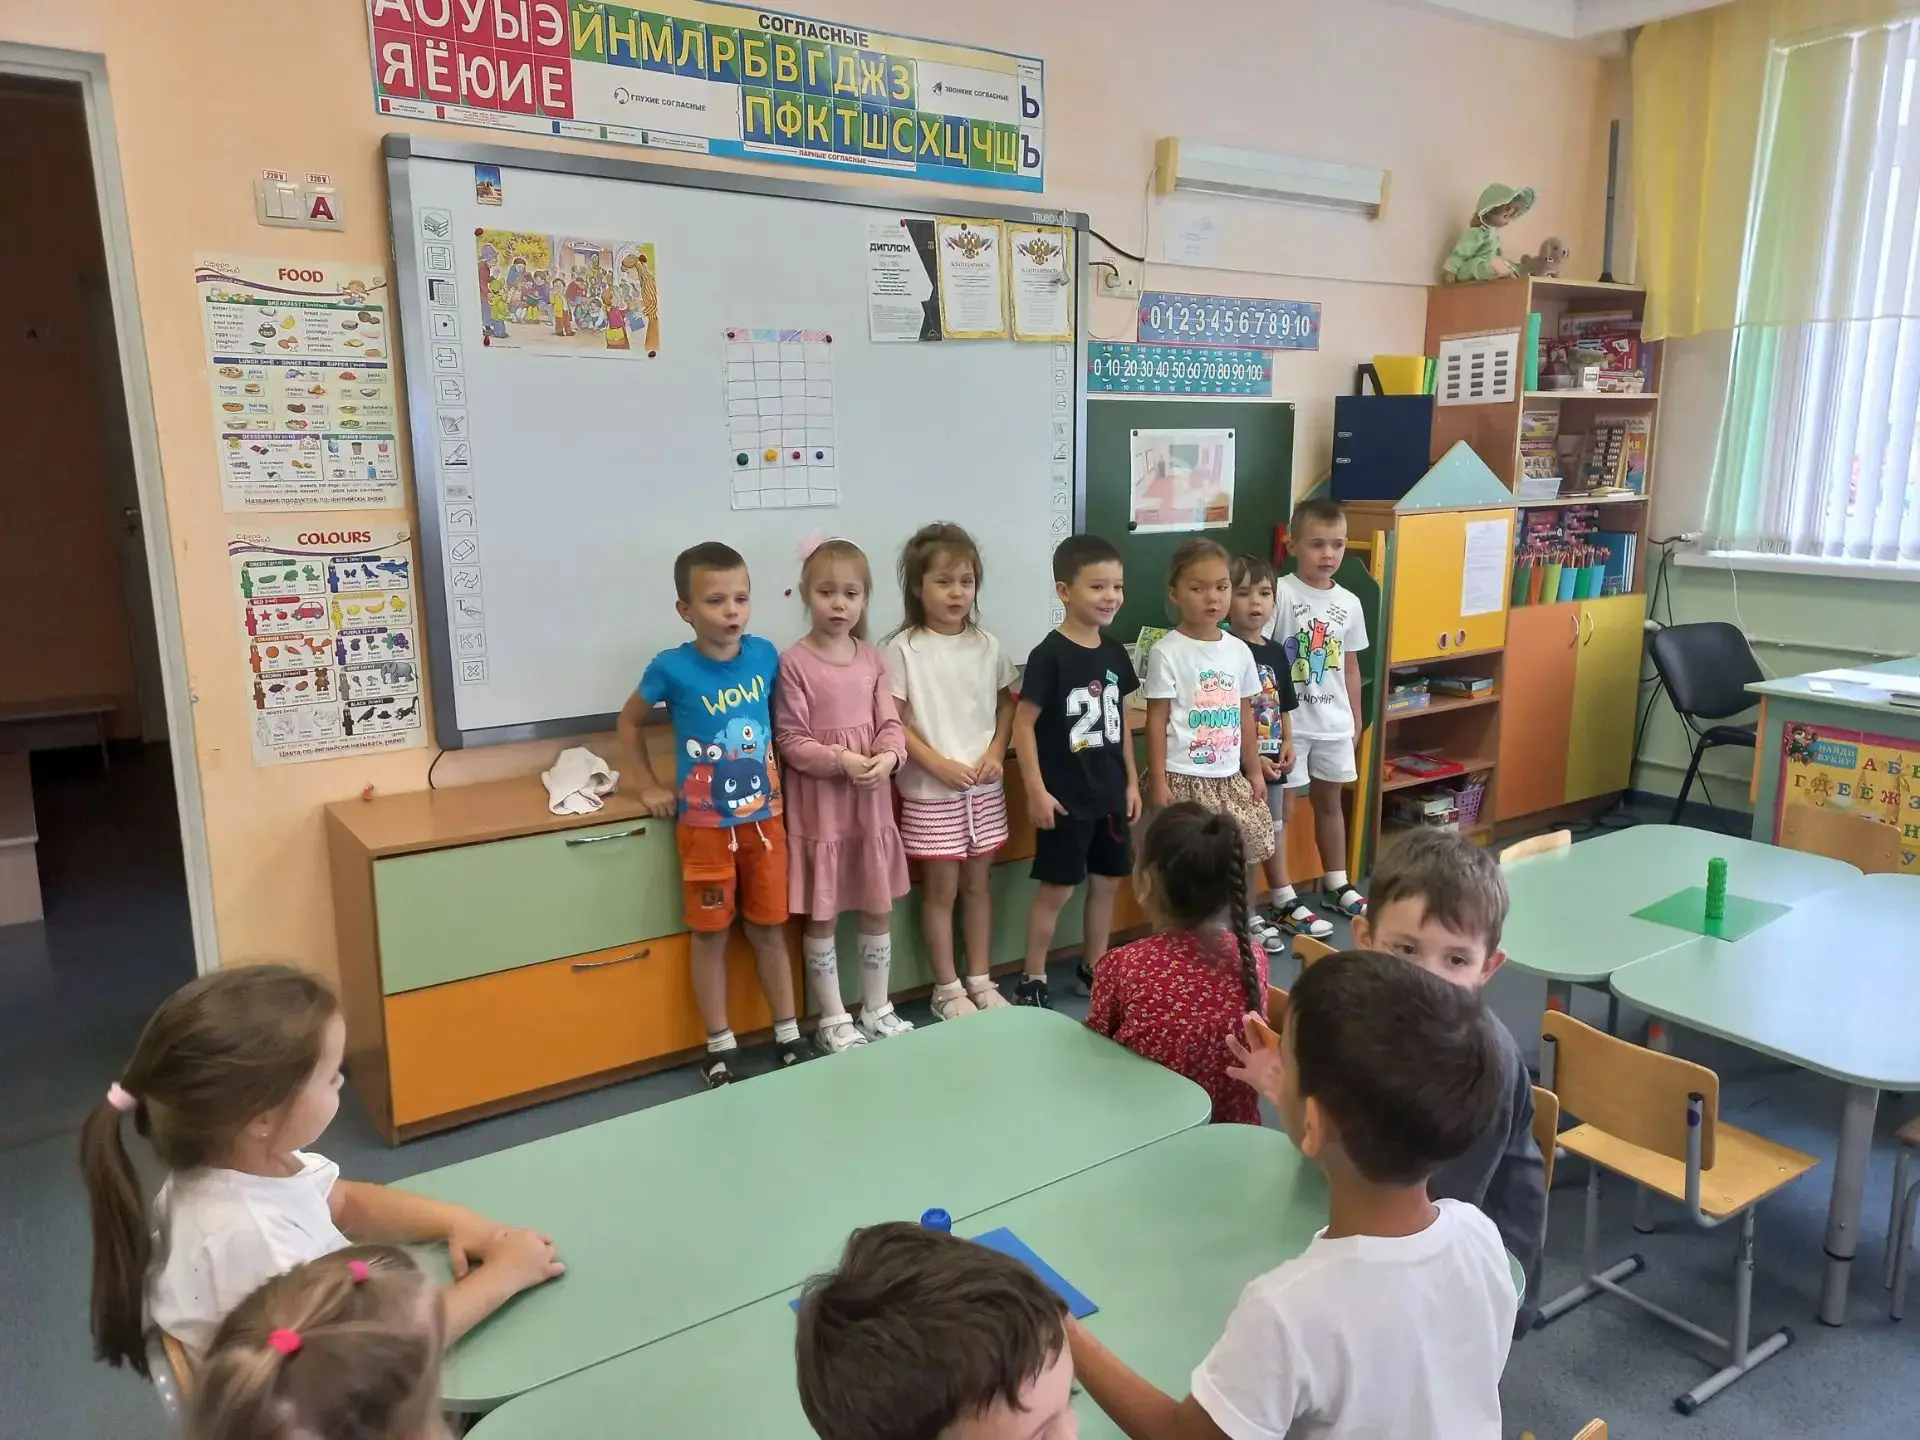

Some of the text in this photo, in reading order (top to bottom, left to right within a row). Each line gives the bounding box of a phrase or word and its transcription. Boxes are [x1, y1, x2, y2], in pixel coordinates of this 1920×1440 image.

[758, 14, 869, 48] СОГЛАСНЫЕ
[630, 94, 707, 111] ГЛУХИЕ СОГЛАСНЫЕ
[869, 242, 911, 253] ДИПЛОМ
[278, 268, 324, 283] FOOD
[1150, 305, 1310, 337] 0 1 2 3 4 5 6 7 8 9 10
[1094, 359, 1263, 381] 0 10 20 30 40 50 60 70 80 90 100
[297, 531, 371, 545] COLOURS
[1862, 758, 1878, 772] А
[1887, 761, 1902, 775] Б
[1794, 774, 1807, 787] Г
[1837, 782, 1851, 796] Е
[1860, 783, 1874, 800] Ё
[1880, 790, 1901, 806] Ж
[1900, 849, 1917, 865] У
